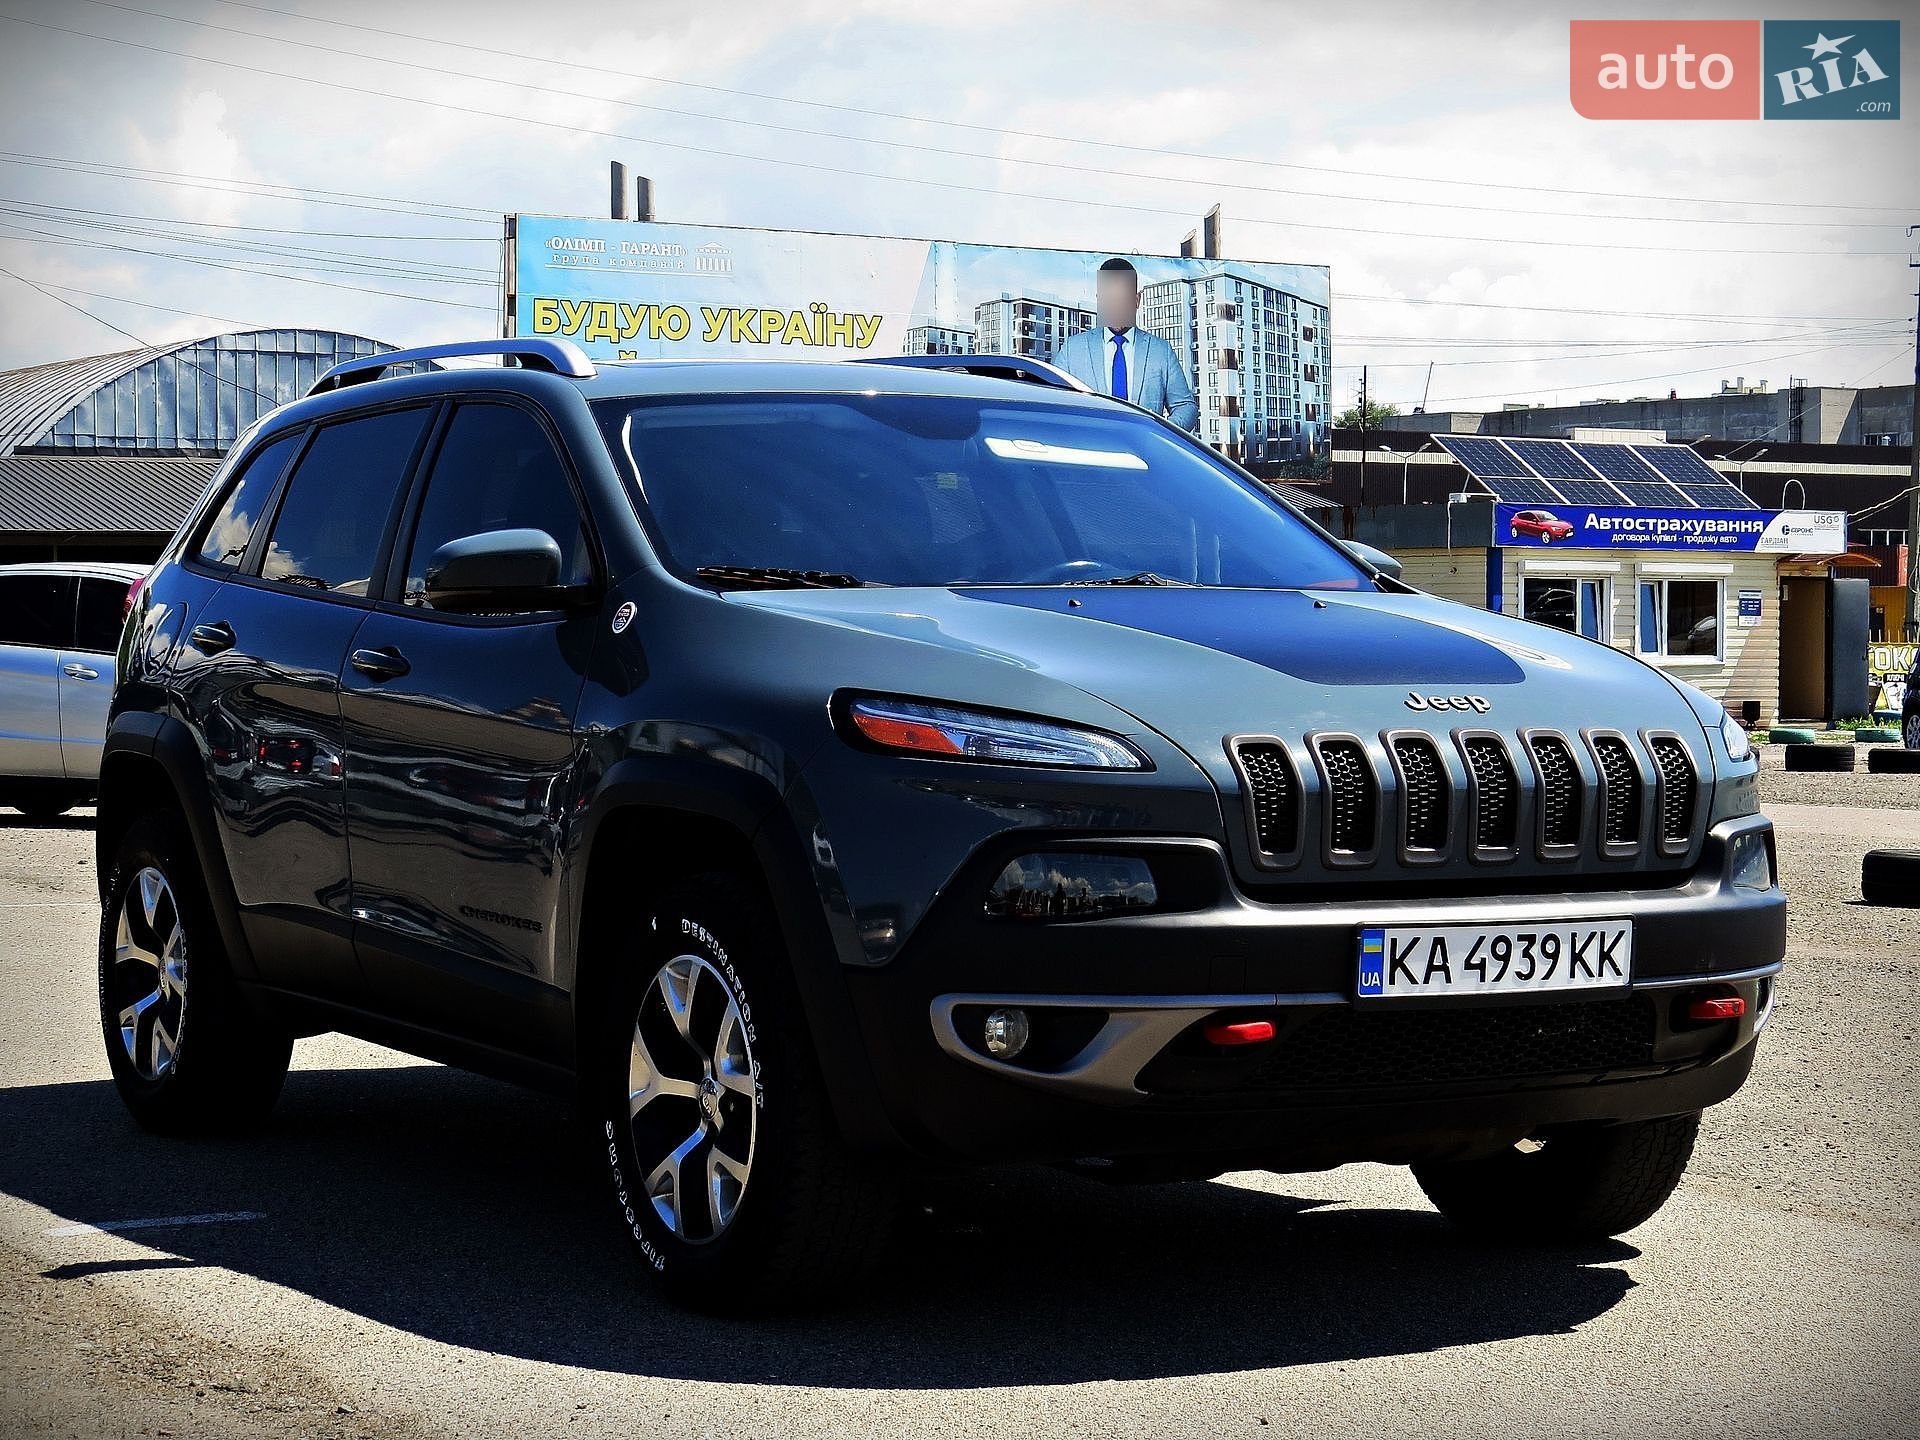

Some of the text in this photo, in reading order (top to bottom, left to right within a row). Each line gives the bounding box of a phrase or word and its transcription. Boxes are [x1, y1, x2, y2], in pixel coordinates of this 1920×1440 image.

[552, 254, 600, 265] група
[533, 298, 882, 348] БУДУЮ УКРАЇНУ
[1584, 512, 1764, 535] Автострахування
[1611, 533, 1651, 543] договора
[1683, 535, 1719, 544] продажу
[1403, 692, 1492, 715] Jeep
[1388, 930, 1626, 986] KA 4939 KK
[1361, 971, 1381, 987] UA
